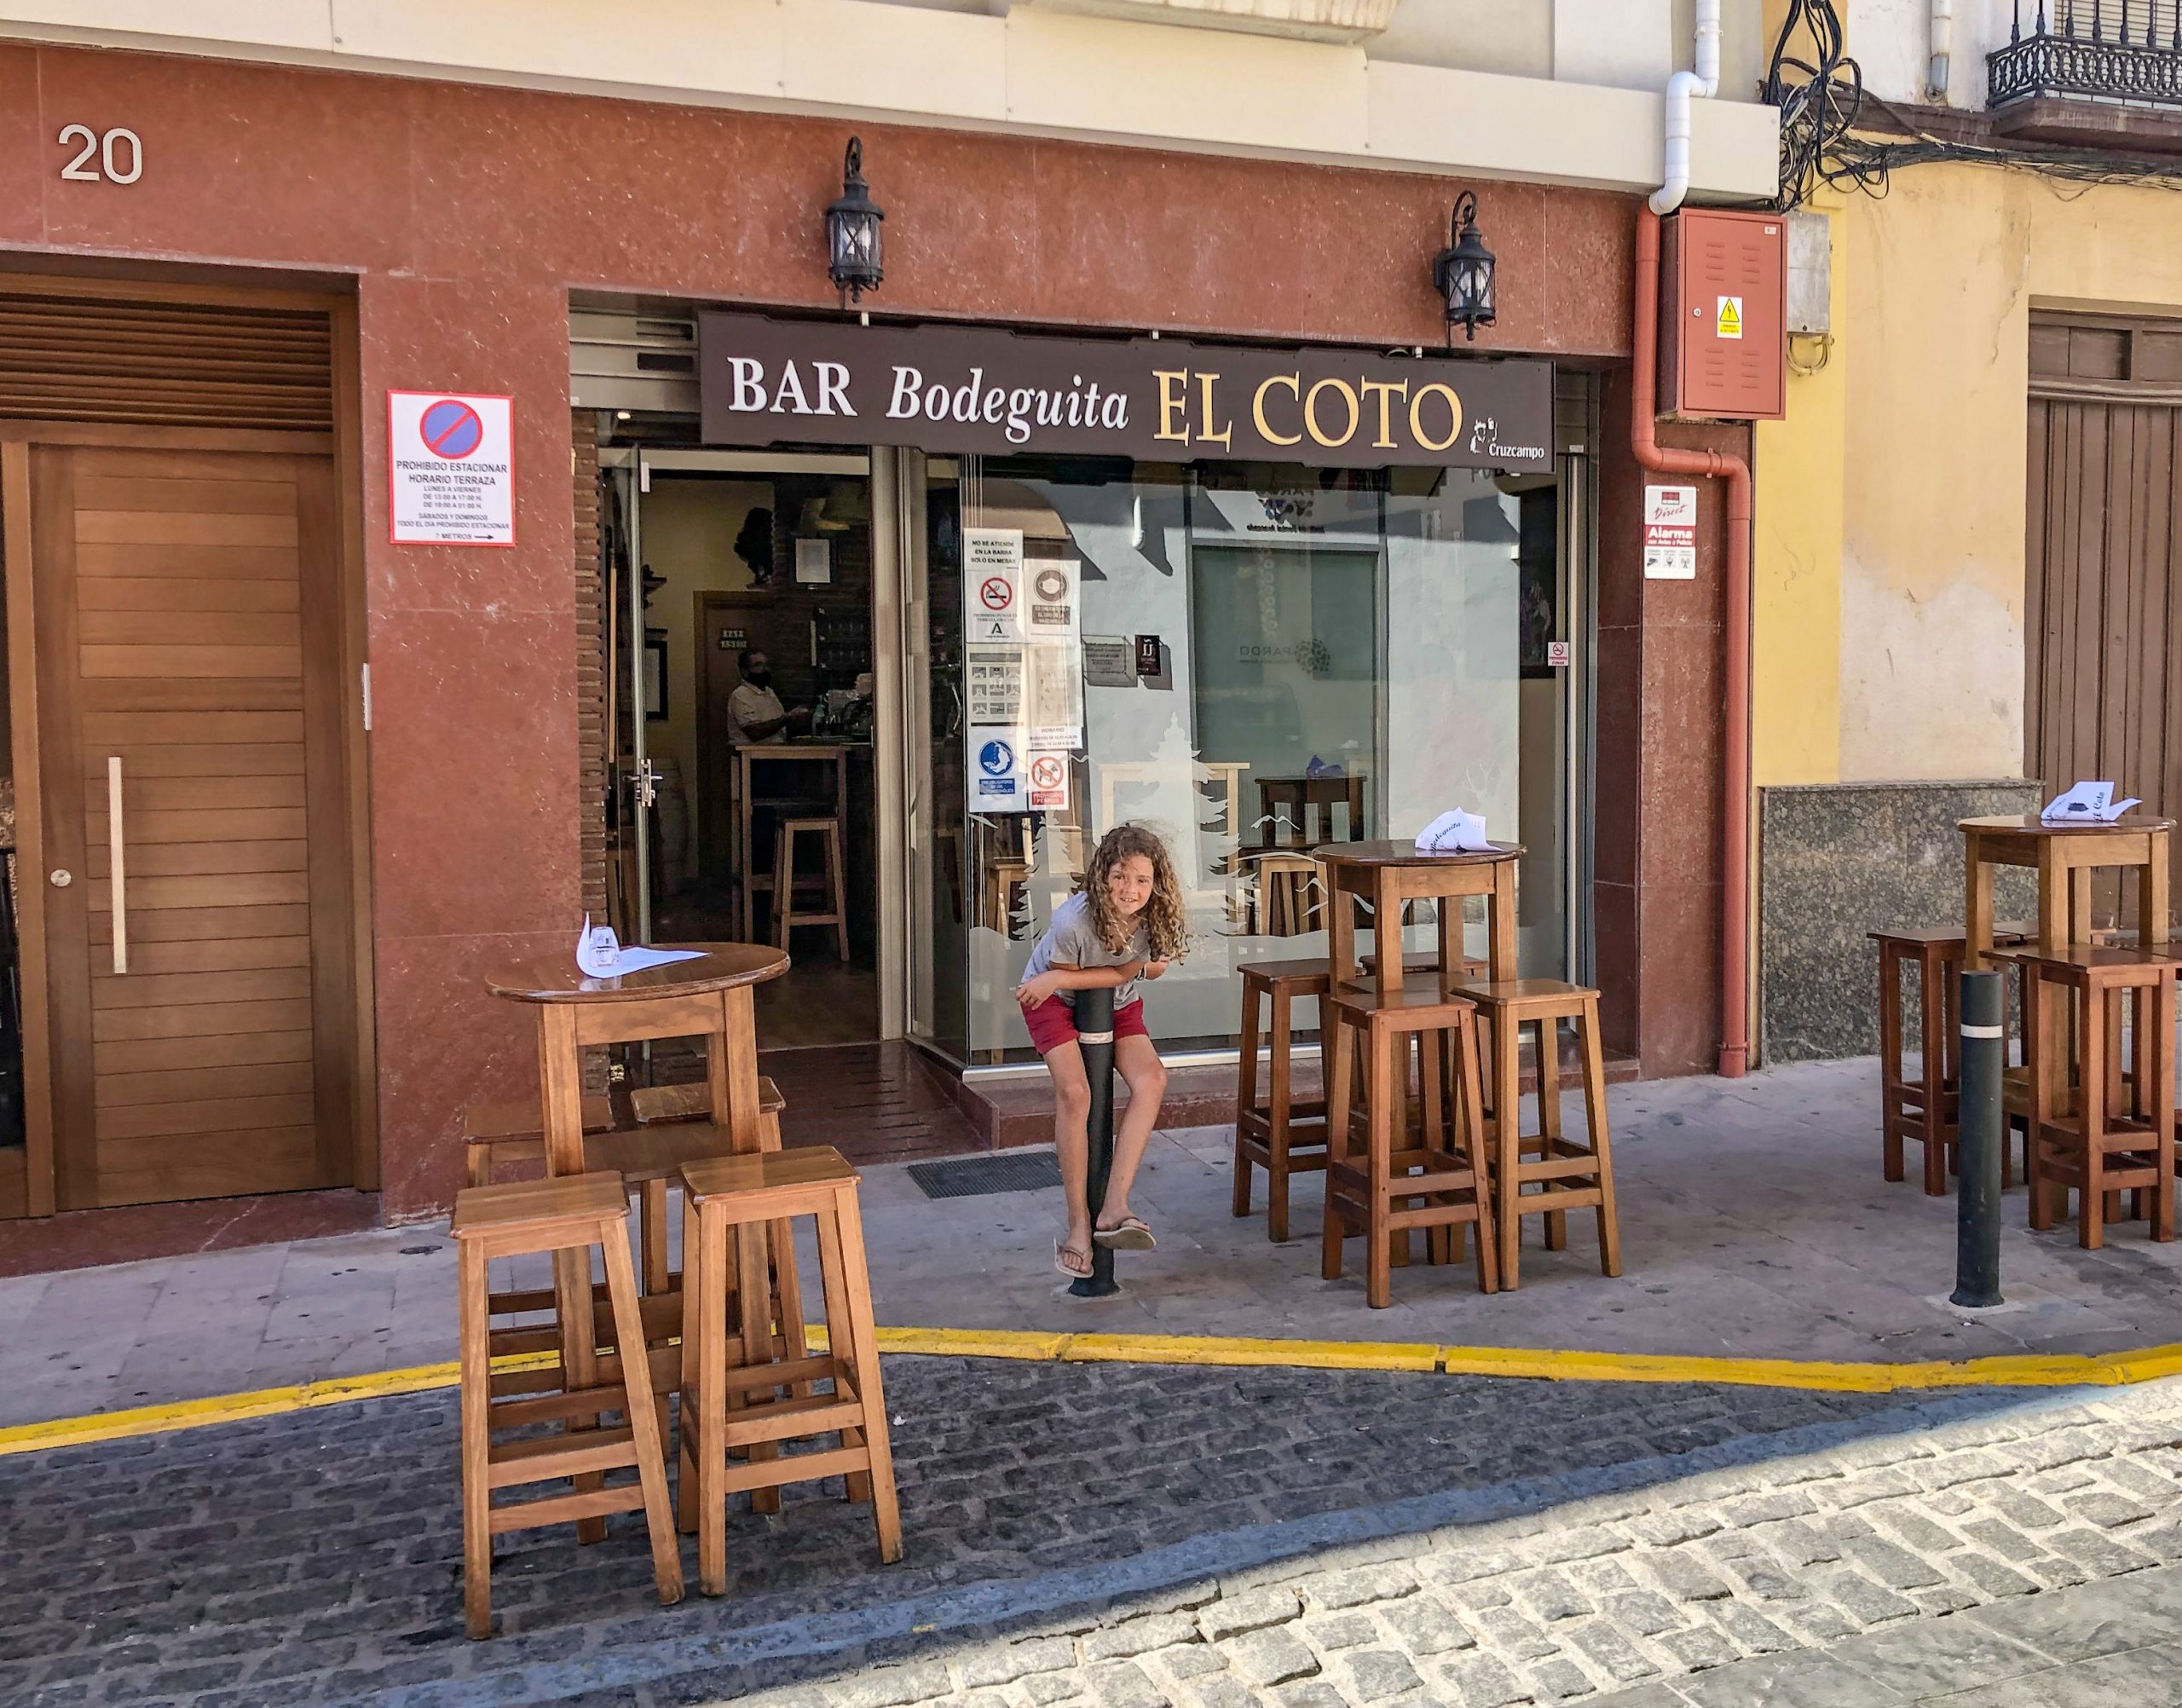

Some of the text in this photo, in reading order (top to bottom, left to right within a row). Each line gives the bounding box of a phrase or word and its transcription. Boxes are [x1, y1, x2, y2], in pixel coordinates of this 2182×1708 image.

[58, 124, 143, 185] 20
[727, 356, 1463, 453] BAR Bodeguita EL COTO
[1488, 442, 1545, 461] Cruzcampo
[396, 460, 508, 473] PROHIBIDO ESTACIONAR
[409, 474, 496, 485] HORARIO TERRAZA
[1654, 504, 1688, 520] Direct
[1648, 526, 1693, 540] Alarma
